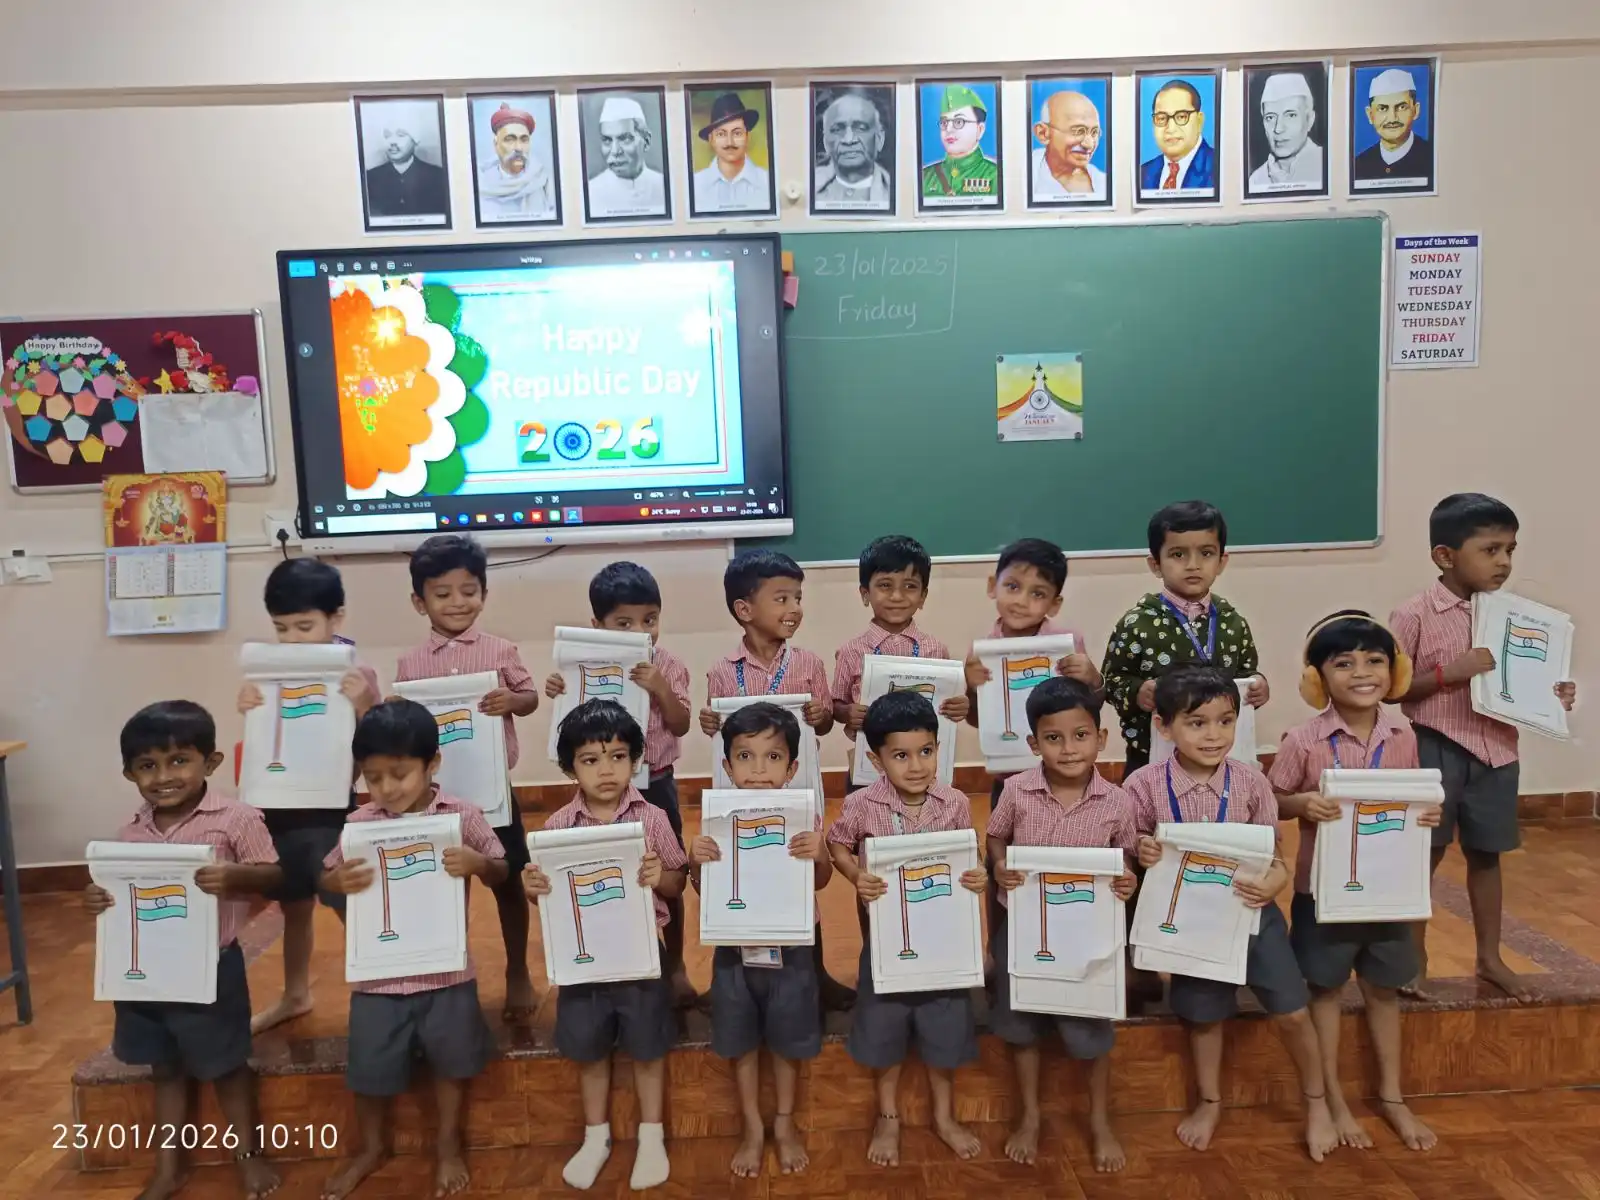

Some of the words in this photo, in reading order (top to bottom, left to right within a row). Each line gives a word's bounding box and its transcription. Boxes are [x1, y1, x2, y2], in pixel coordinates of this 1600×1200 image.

[1404, 239, 1422, 248] Days
[1424, 238, 1433, 246] of
[1434, 238, 1447, 246] the
[1448, 237, 1469, 245] Week
[1411, 253, 1461, 264] SUNDAY
[1409, 269, 1463, 280] MONDAY
[1408, 285, 1463, 296] TUESDAY
[838, 295, 917, 329] Friday
[1397, 300, 1472, 312] WEDNESDAY
[1402, 316, 1466, 328] THURSDAY
[543, 323, 641, 355] Happy
[1412, 333, 1455, 343] FRIDAY
[28, 342, 56, 350] Happy
[59, 341, 100, 349] Birthday
[1401, 348, 1464, 360] SATURDAY
[490, 367, 631, 401] Republic
[642, 365, 700, 397] Day
[519, 416, 661, 463] 2026
